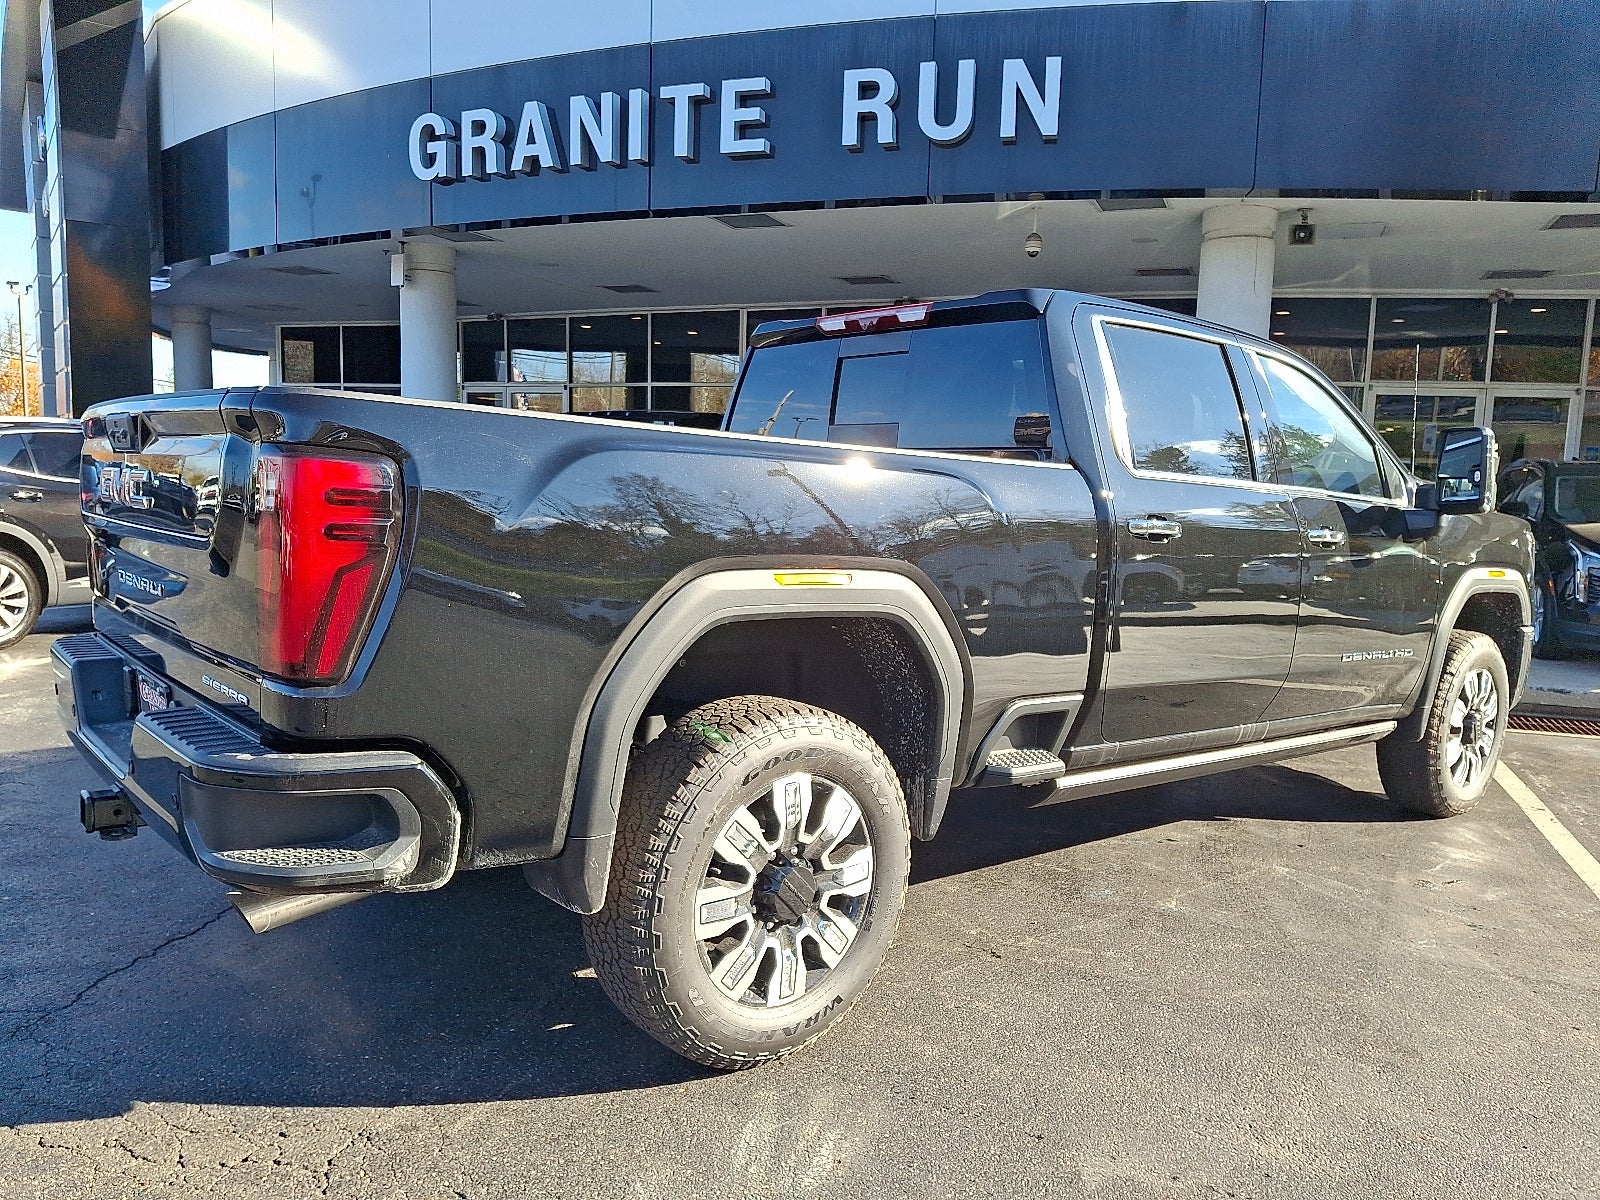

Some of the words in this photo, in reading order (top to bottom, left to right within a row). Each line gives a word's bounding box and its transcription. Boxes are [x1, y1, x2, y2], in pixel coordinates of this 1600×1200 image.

[408, 76, 772, 183] GRANITE
[841, 56, 1062, 149] RUN
[100, 467, 156, 510] GMC
[118, 569, 165, 597] DENALI
[1341, 650, 1395, 662] DENALI
[1395, 648, 1414, 658] HD
[201, 675, 249, 706] SIERRA
